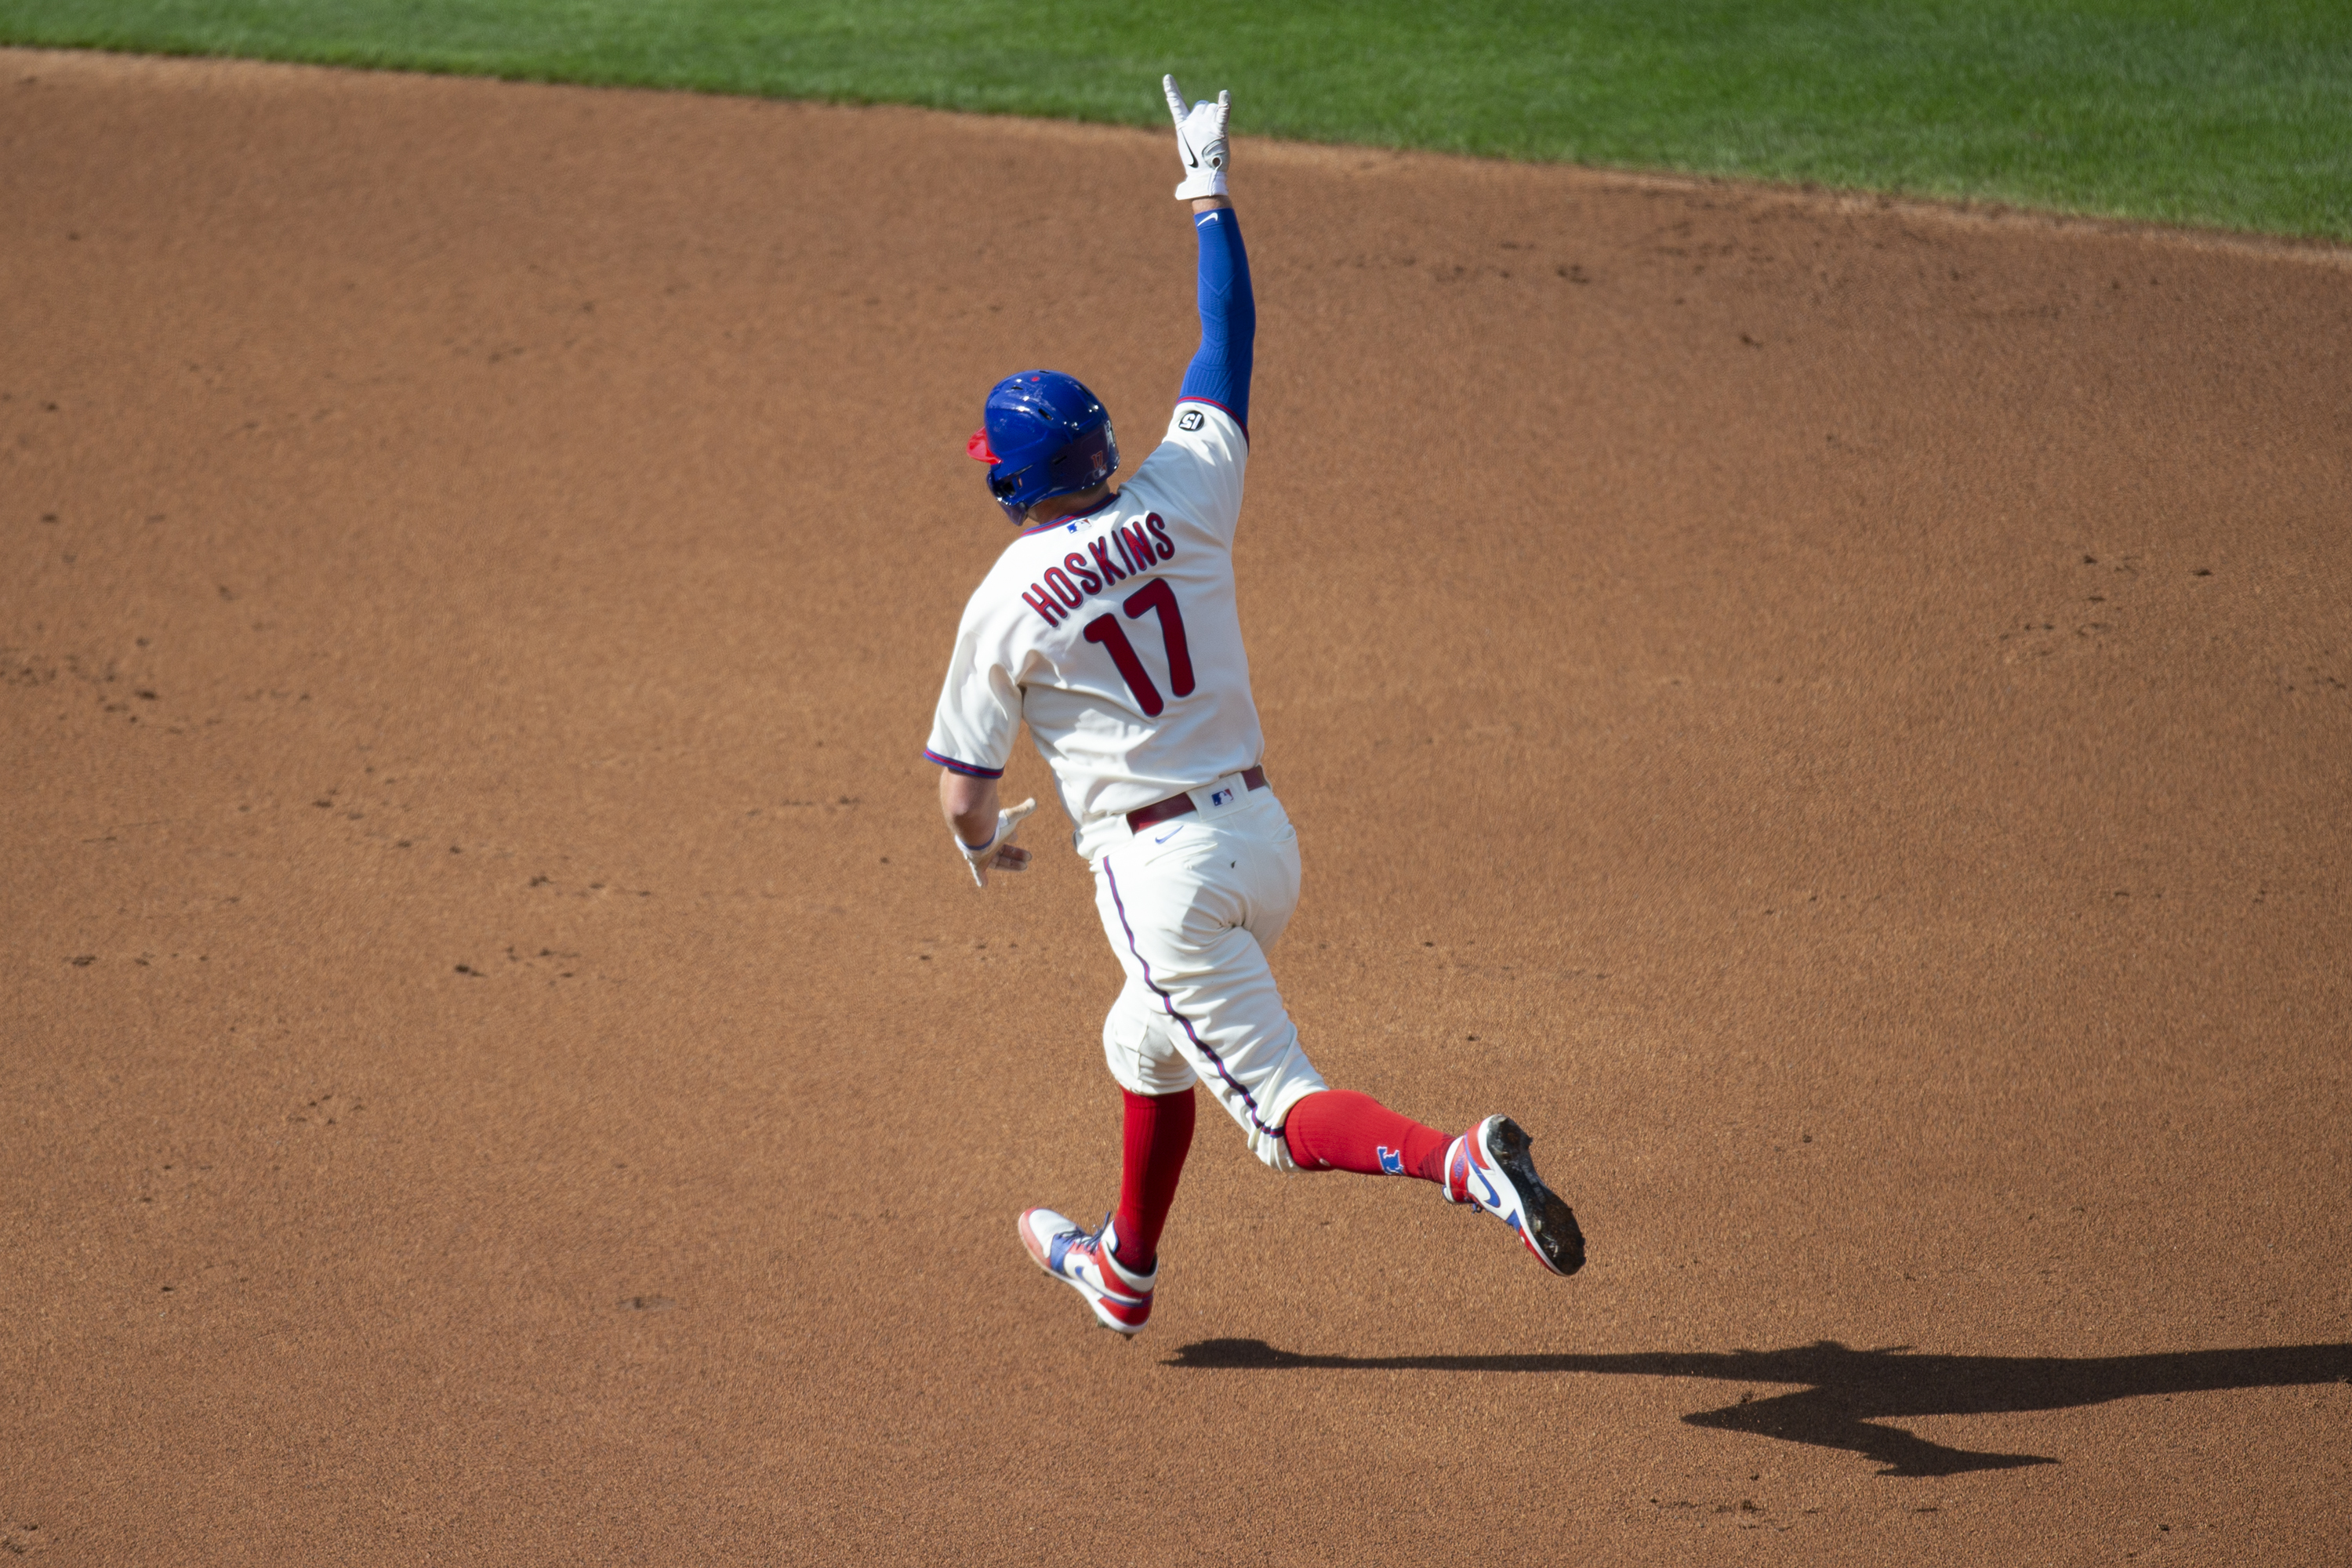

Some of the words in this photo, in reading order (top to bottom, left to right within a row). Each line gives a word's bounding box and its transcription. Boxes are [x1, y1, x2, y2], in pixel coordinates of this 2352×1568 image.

[1091, 450, 1103, 469] 17
[1022, 512, 1175, 627] HOSKINS
[1083, 577, 1196, 717] 17
